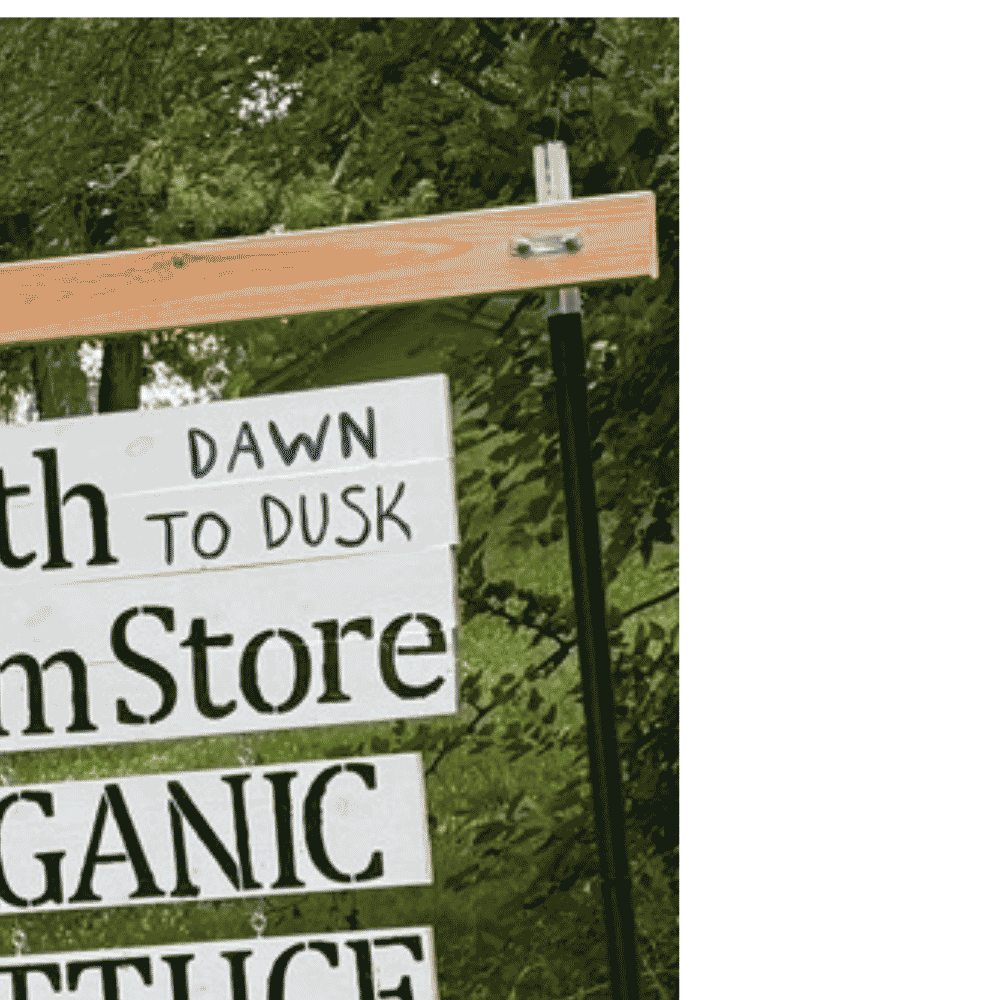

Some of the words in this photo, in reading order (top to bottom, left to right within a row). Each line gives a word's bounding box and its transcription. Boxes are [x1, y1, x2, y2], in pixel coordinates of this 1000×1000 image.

[187, 406, 377, 479] DAWN
[144, 510, 232, 566] TO
[260, 481, 412, 550] DUSK
[109, 605, 448, 725] Store
